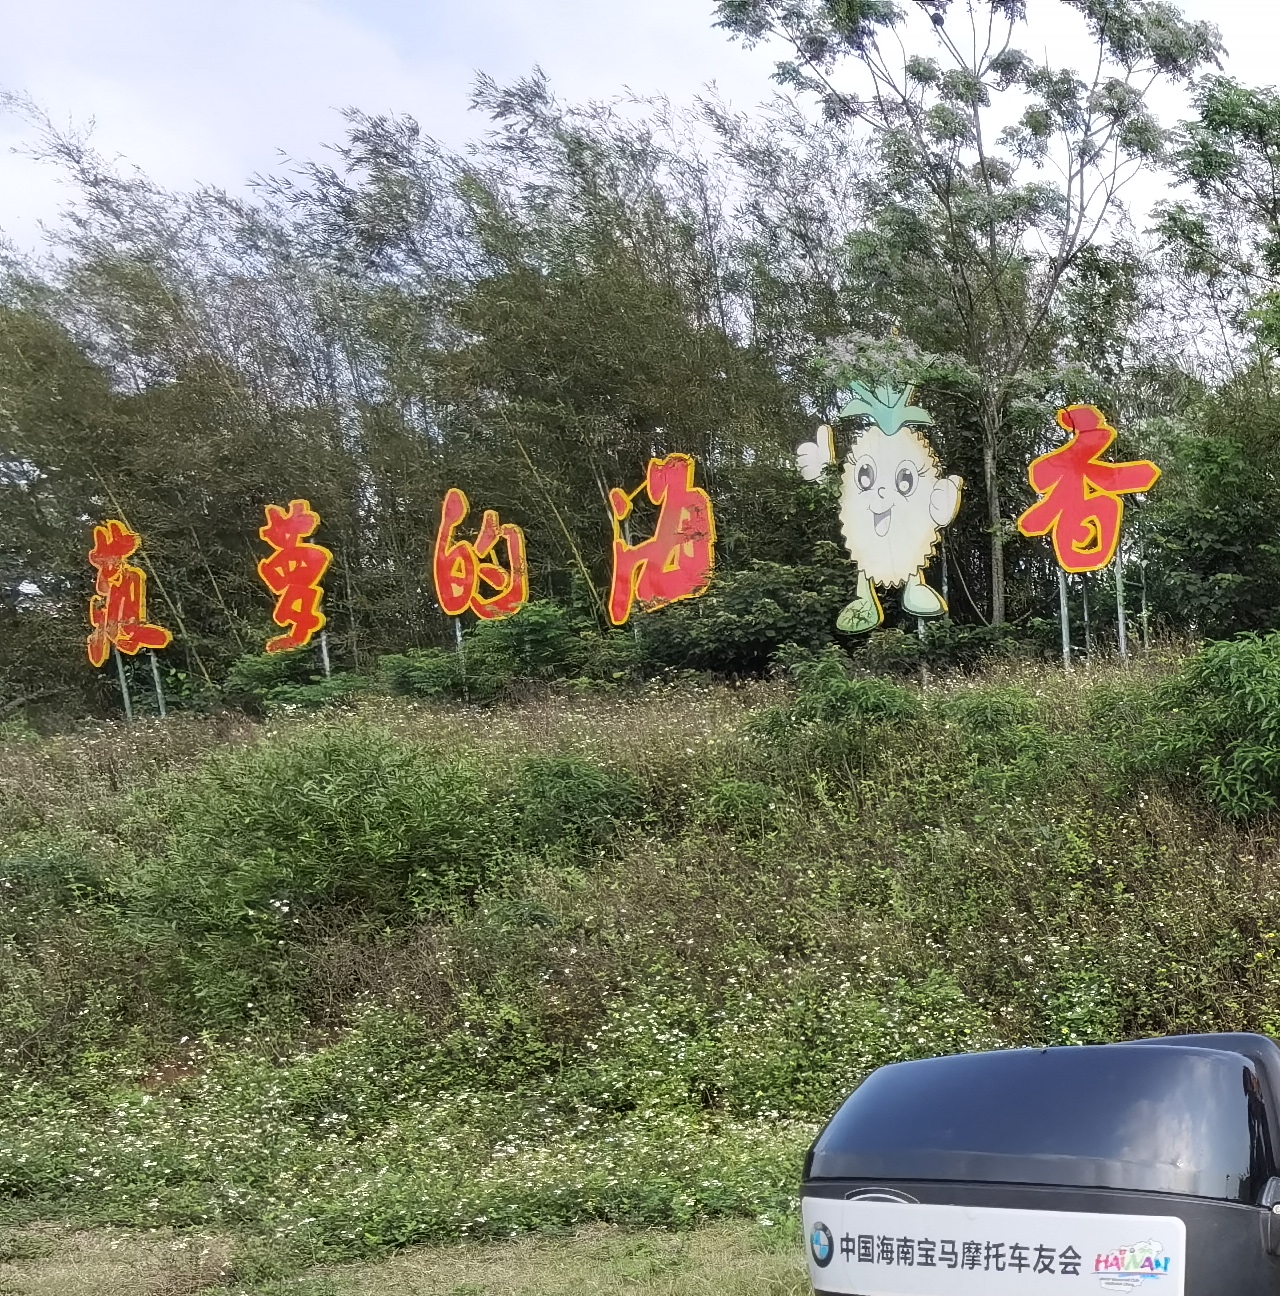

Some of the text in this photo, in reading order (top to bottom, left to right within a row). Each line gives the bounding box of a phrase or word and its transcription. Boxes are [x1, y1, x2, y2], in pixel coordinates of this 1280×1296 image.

[839, 1231, 1082, 1277] 中国海南宝马摩托车友会
